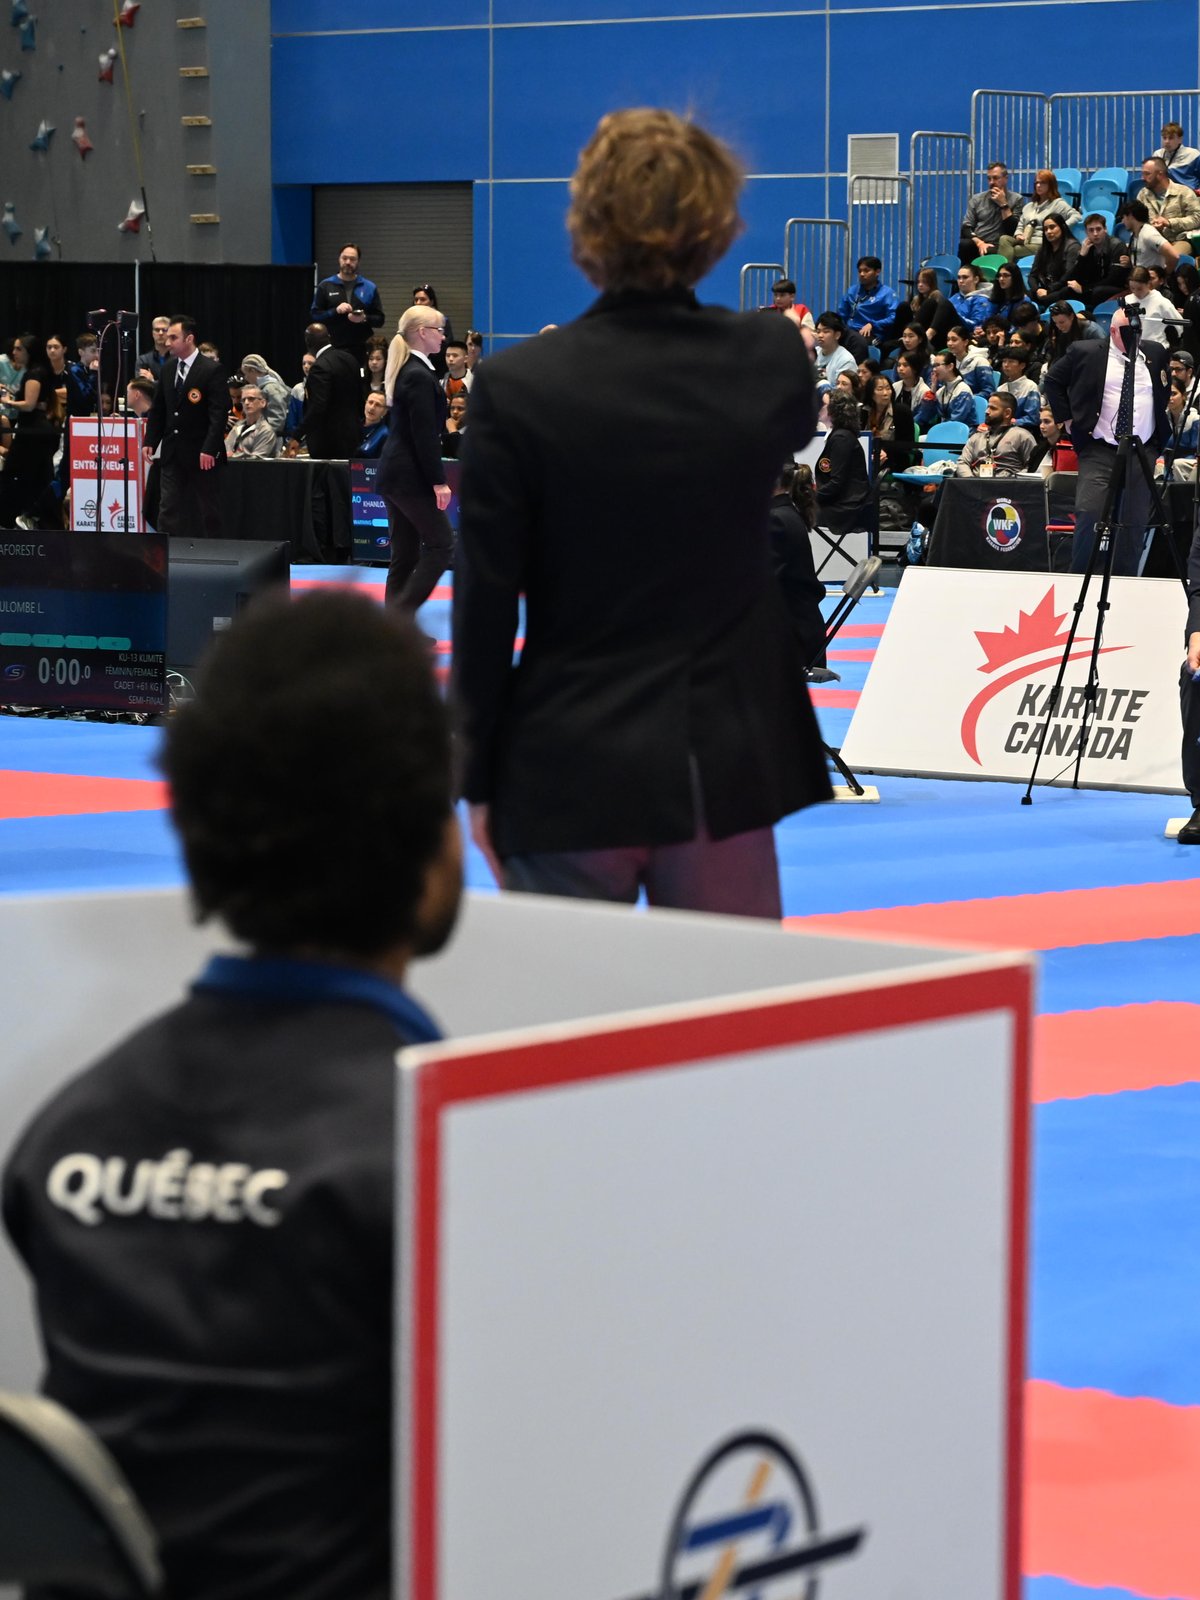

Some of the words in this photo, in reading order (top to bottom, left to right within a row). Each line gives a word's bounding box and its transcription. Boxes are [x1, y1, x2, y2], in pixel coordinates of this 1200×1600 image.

[993, 519, 1014, 531] WKF
[139, 653, 164, 664] KUMITE
[113, 680, 135, 690] CADET
[149, 681, 159, 692] KG
[128, 695, 165, 706] SEMI-FINAL
[1016, 683, 1150, 723] KARATE
[1004, 721, 1134, 761] CANADA
[46, 1148, 290, 1227] QUÉBEC
